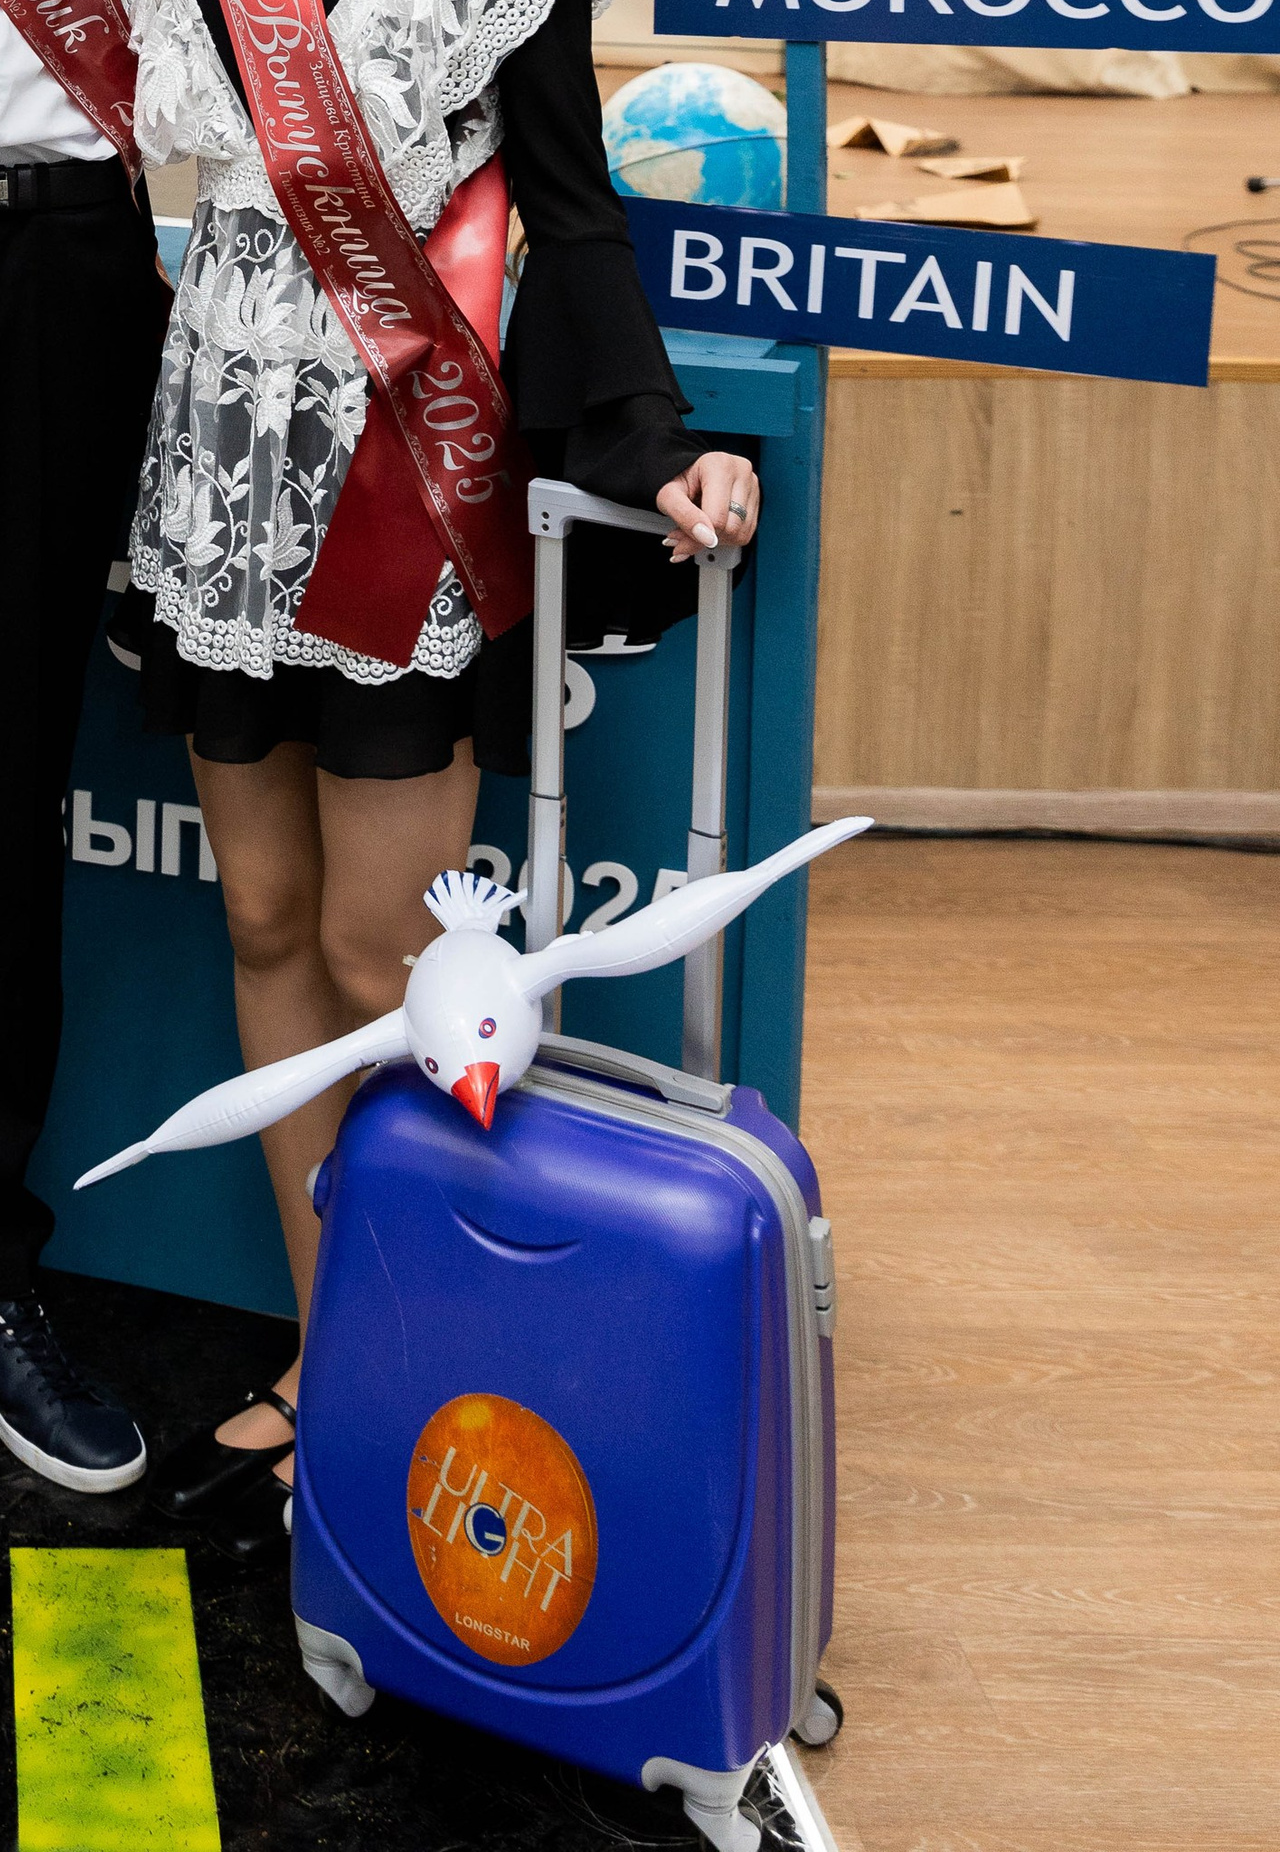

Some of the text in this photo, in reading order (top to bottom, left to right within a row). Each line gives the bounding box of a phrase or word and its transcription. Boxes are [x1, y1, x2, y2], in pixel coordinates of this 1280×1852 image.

[309, 61, 375, 209] Зайцева Кристина
[278, 170, 314, 232] Гимназия
[670, 229, 1076, 343] BRITAIN
[407, 360, 496, 505] 2025
[61, 789, 218, 883] ЫП
[422, 1482, 572, 1613] LIGHT
[439, 1445, 573, 1578] ULTRA
[455, 1612, 531, 1652] LONGSTAR
